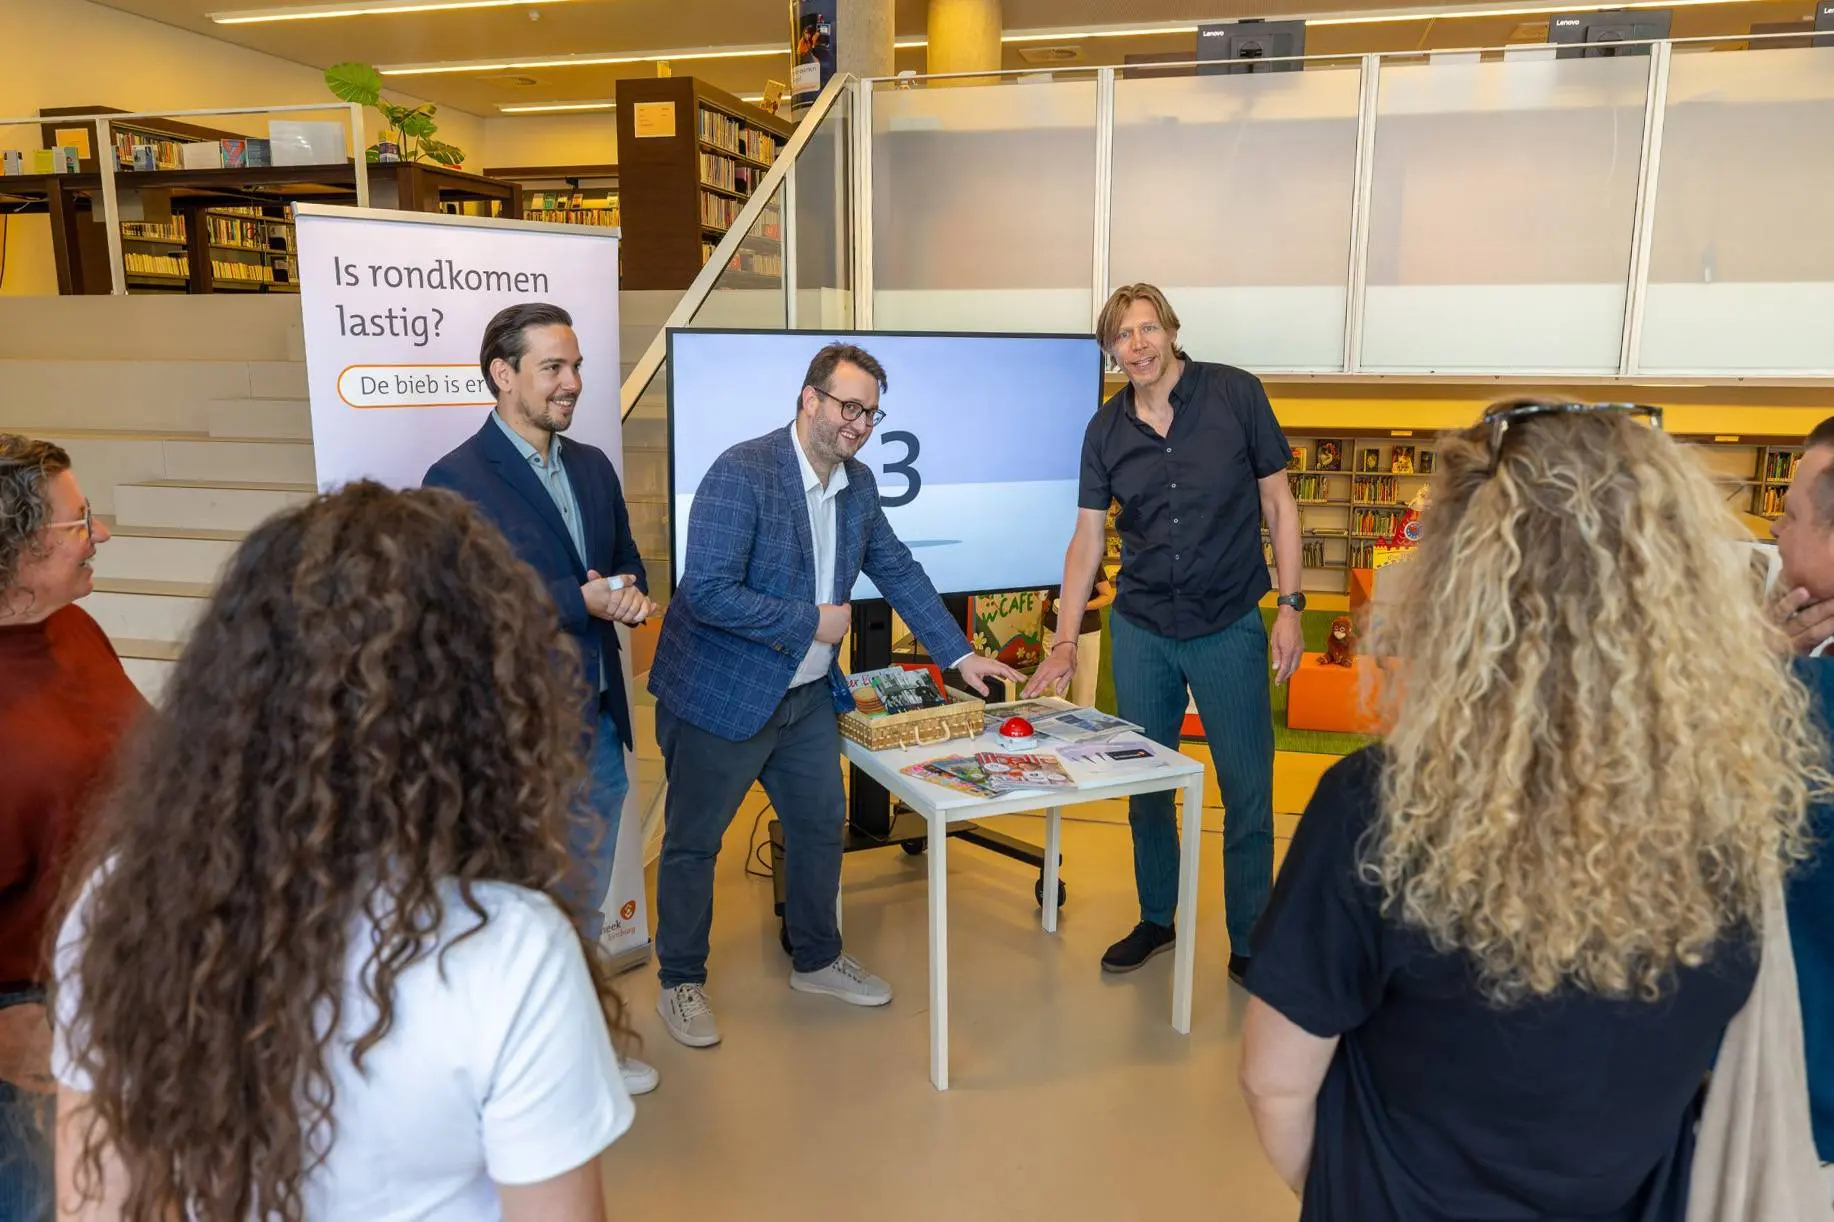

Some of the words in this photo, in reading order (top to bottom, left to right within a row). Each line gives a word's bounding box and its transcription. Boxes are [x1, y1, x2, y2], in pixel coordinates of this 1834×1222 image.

[334, 256, 360, 287] Is
[368, 259, 549, 293] rondkomen
[335, 304, 444, 347] lastig?
[361, 376, 389, 395] De
[394, 374, 439, 394] bieb
[443, 375, 460, 393] is
[465, 377, 485, 393] er
[880, 430, 922, 507] 3
